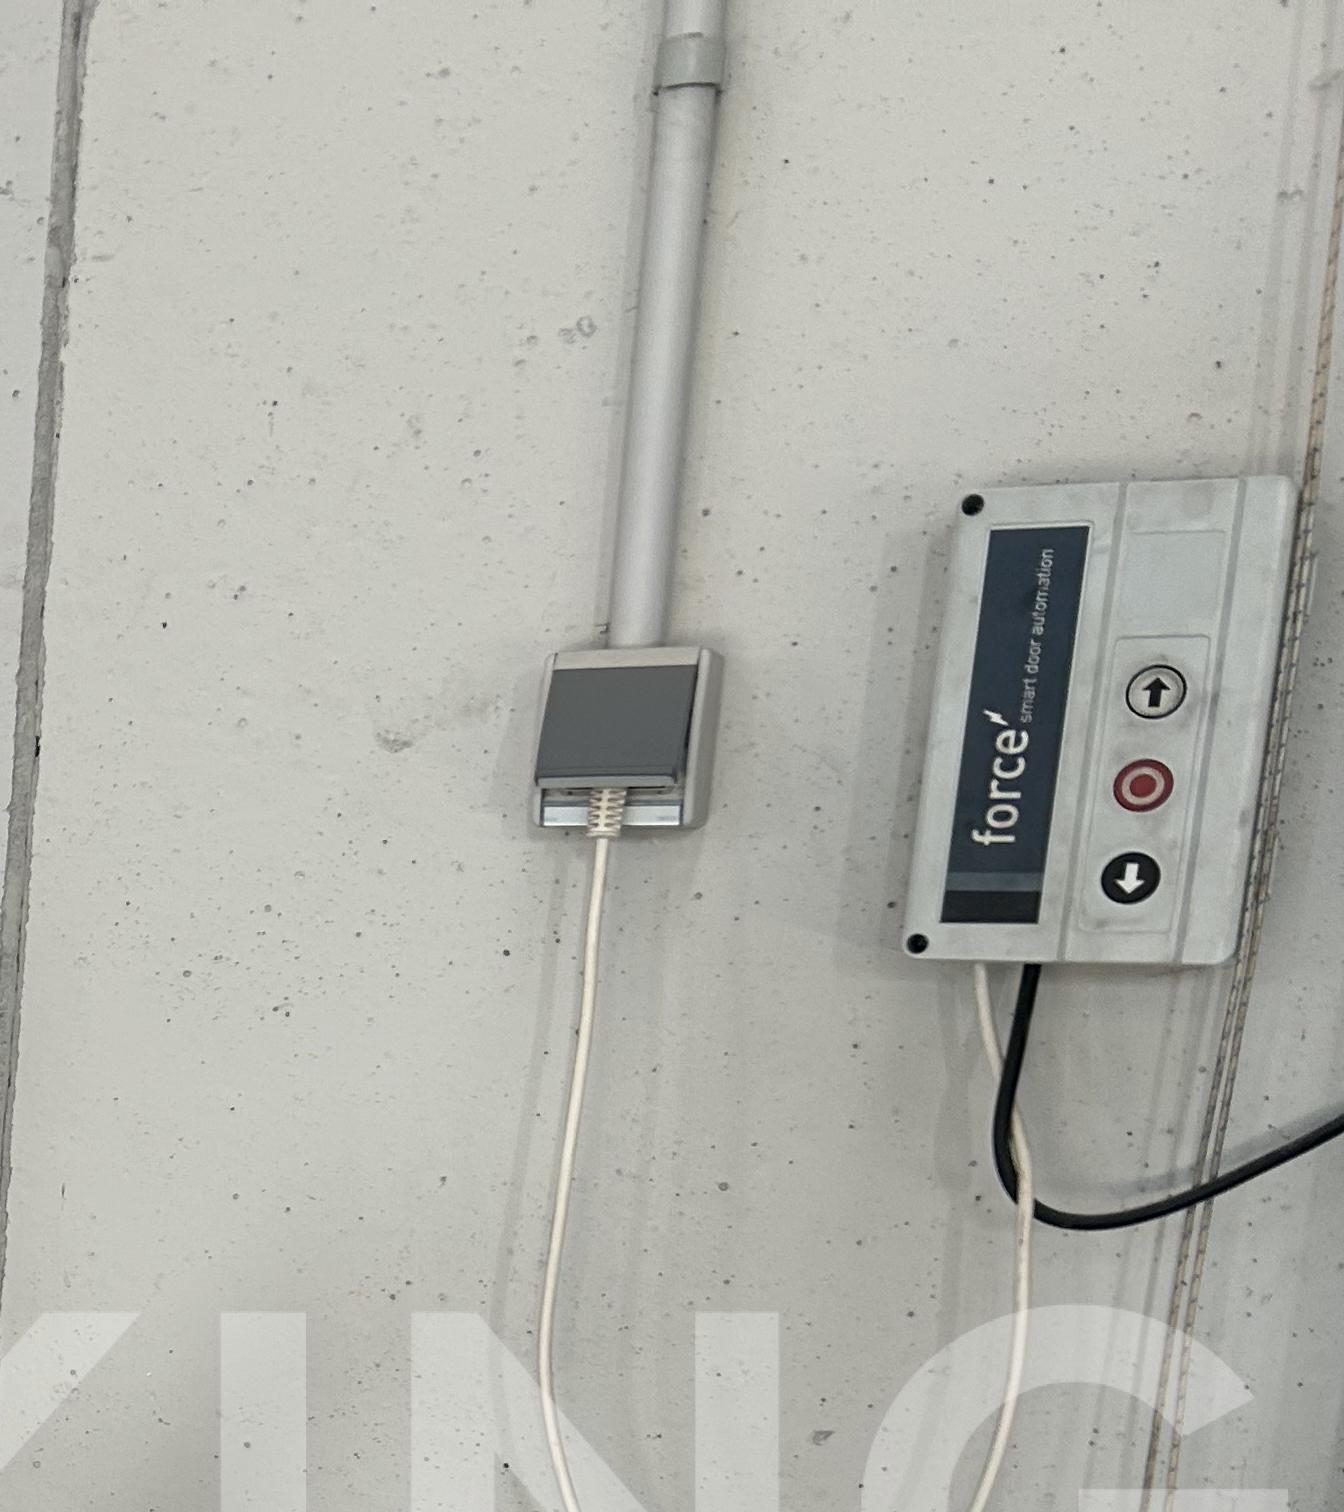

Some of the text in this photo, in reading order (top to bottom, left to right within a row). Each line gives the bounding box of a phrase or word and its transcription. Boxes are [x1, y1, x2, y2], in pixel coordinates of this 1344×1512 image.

[1020, 548, 1054, 724] smart door automation
[971, 728, 1029, 846] force
